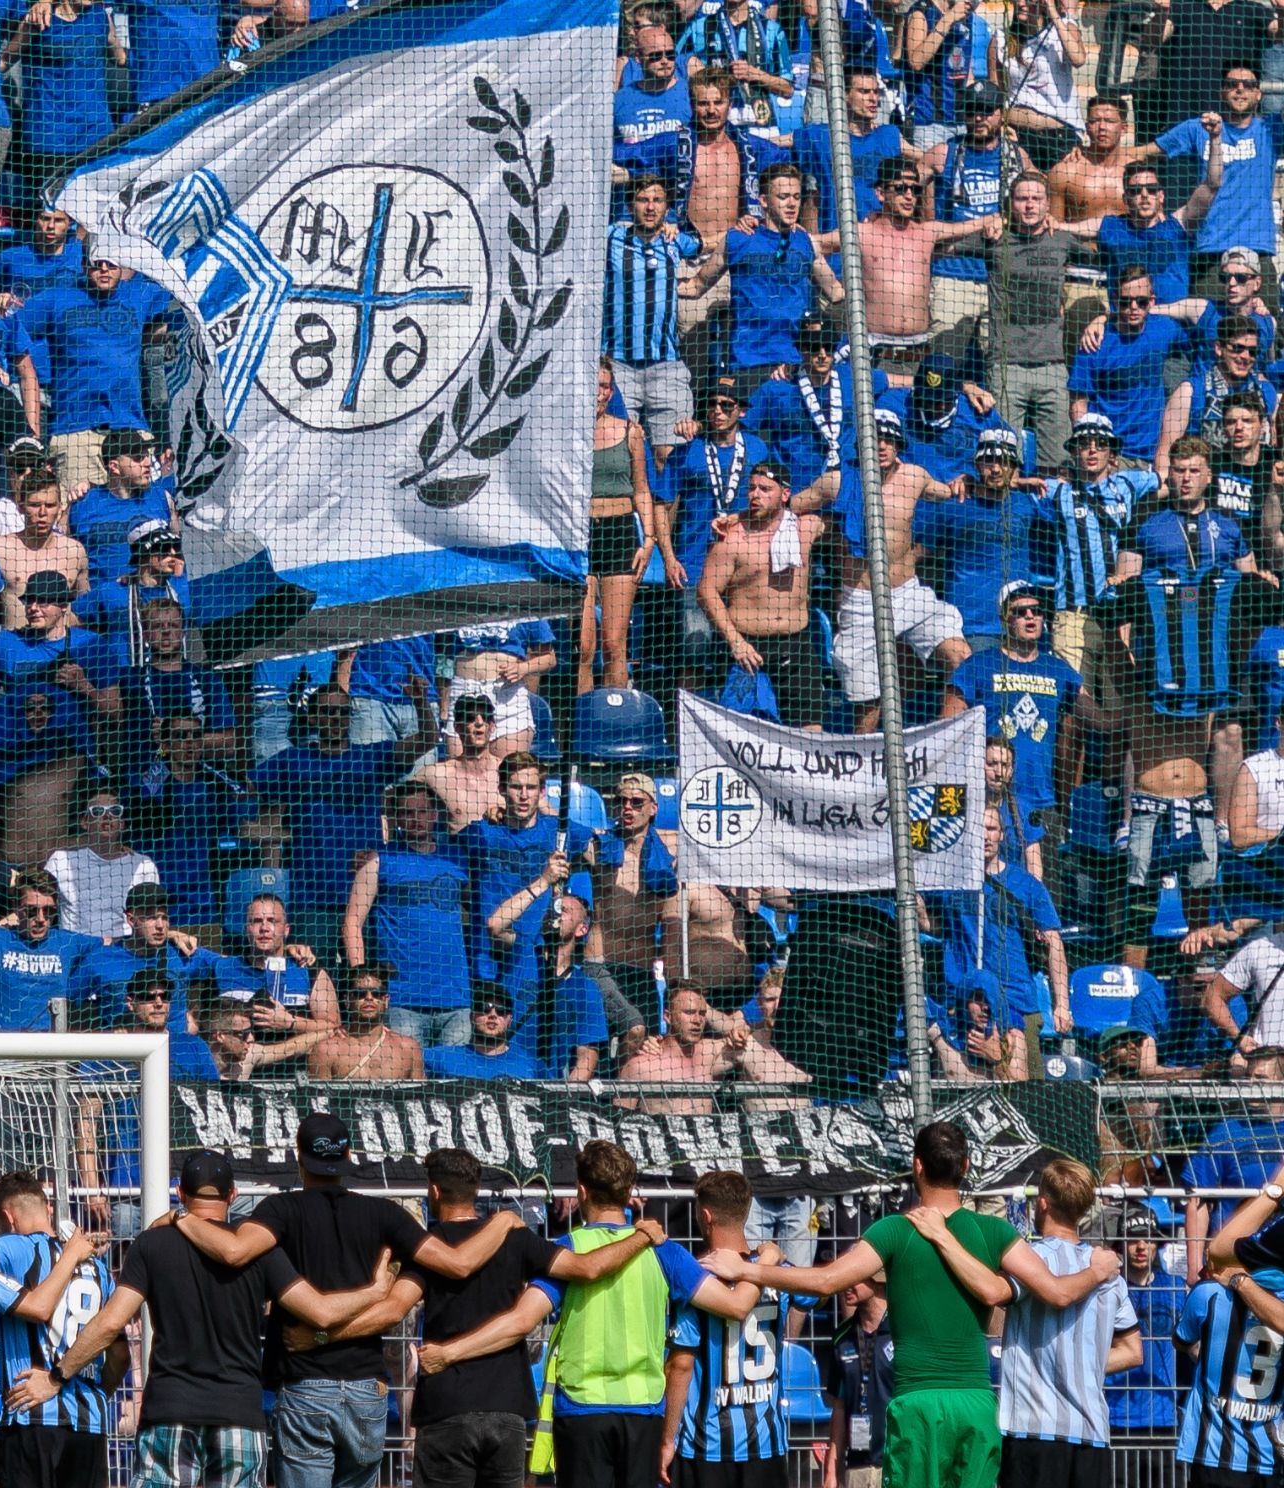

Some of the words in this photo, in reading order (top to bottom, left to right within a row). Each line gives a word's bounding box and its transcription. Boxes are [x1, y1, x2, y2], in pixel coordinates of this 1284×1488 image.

[727, 740, 796, 775] VOLL
[803, 750, 864, 781] UND
[697, 812, 712, 834] 6
[726, 813, 742, 835] 8
[773, 798, 797, 827] IN
[803, 801, 865, 831] LIGA
[723, 1305, 778, 1384] 15
[1236, 1325, 1281, 1400] 3
